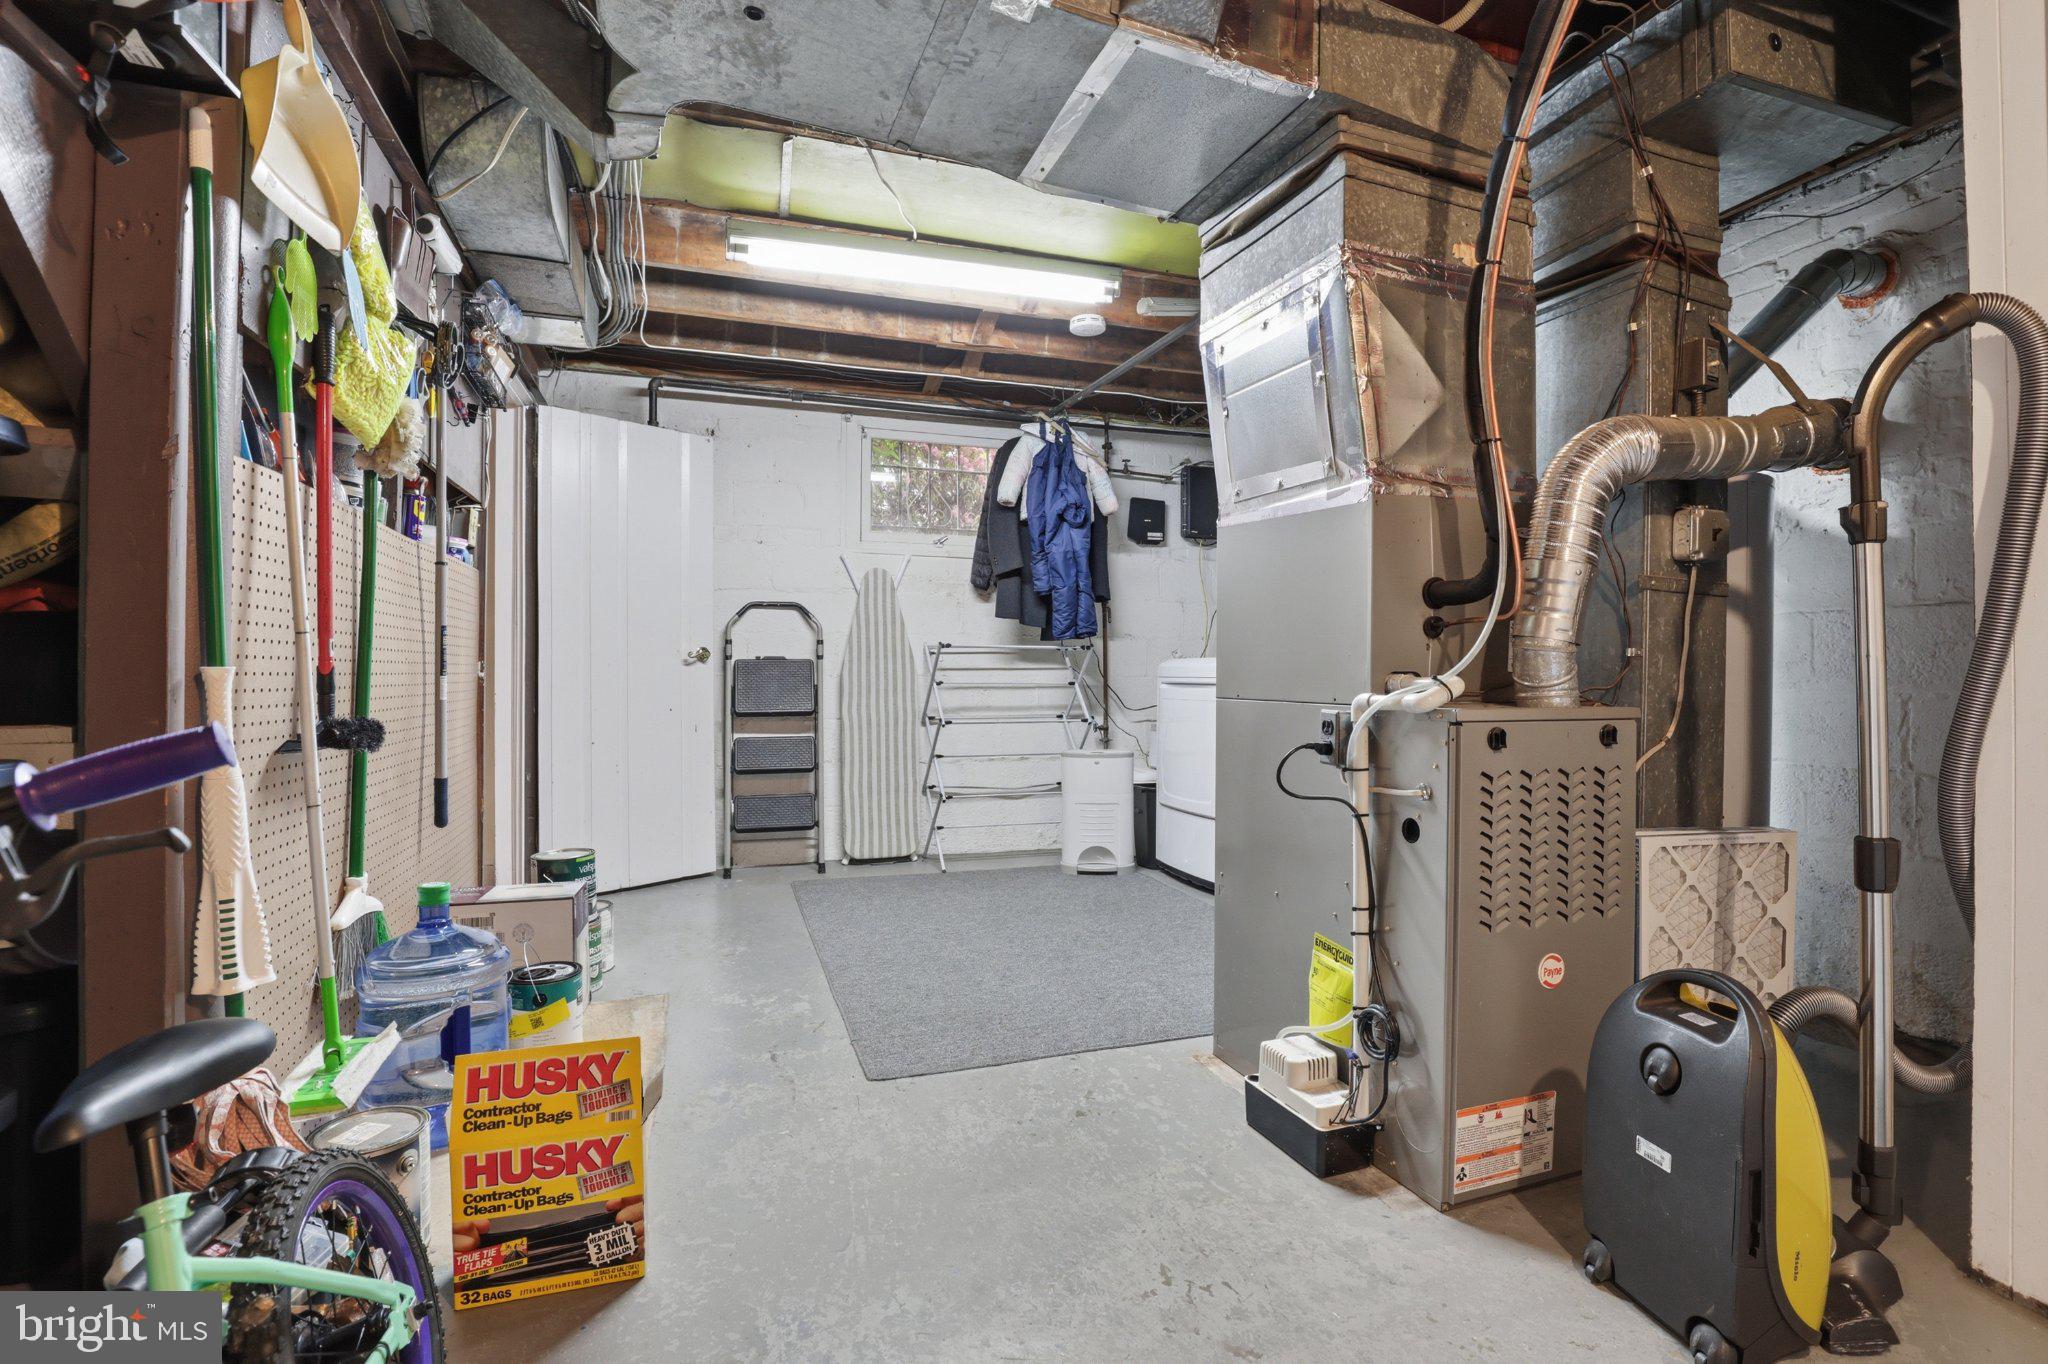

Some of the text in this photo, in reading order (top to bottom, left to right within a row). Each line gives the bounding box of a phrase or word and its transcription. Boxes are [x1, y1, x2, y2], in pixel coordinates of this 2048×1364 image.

[1544, 967, 1562, 978] Payne
[466, 1051, 625, 1104] HUSKY
[582, 1084, 625, 1104] NOTHING'S
[583, 1092, 627, 1113] TOUGHER
[463, 1102, 541, 1120] Contractor
[536, 1110, 573, 1125] Bags
[464, 1135, 625, 1189] HUSKY
[582, 1165, 626, 1185] NOTHING'S
[584, 1173, 628, 1194] TOUGHER
[463, 1186, 542, 1205] Contractor
[536, 1193, 574, 1209] Bags
[589, 1226, 628, 1244] HEAVY DUTY
[593, 1234, 630, 1255] 3 MIL
[456, 1247, 498, 1266] TRUE TIE
[606, 1245, 632, 1259] GALLON
[464, 1258, 493, 1273] FLAPS
[460, 1289, 512, 1305] 32 BAGS
